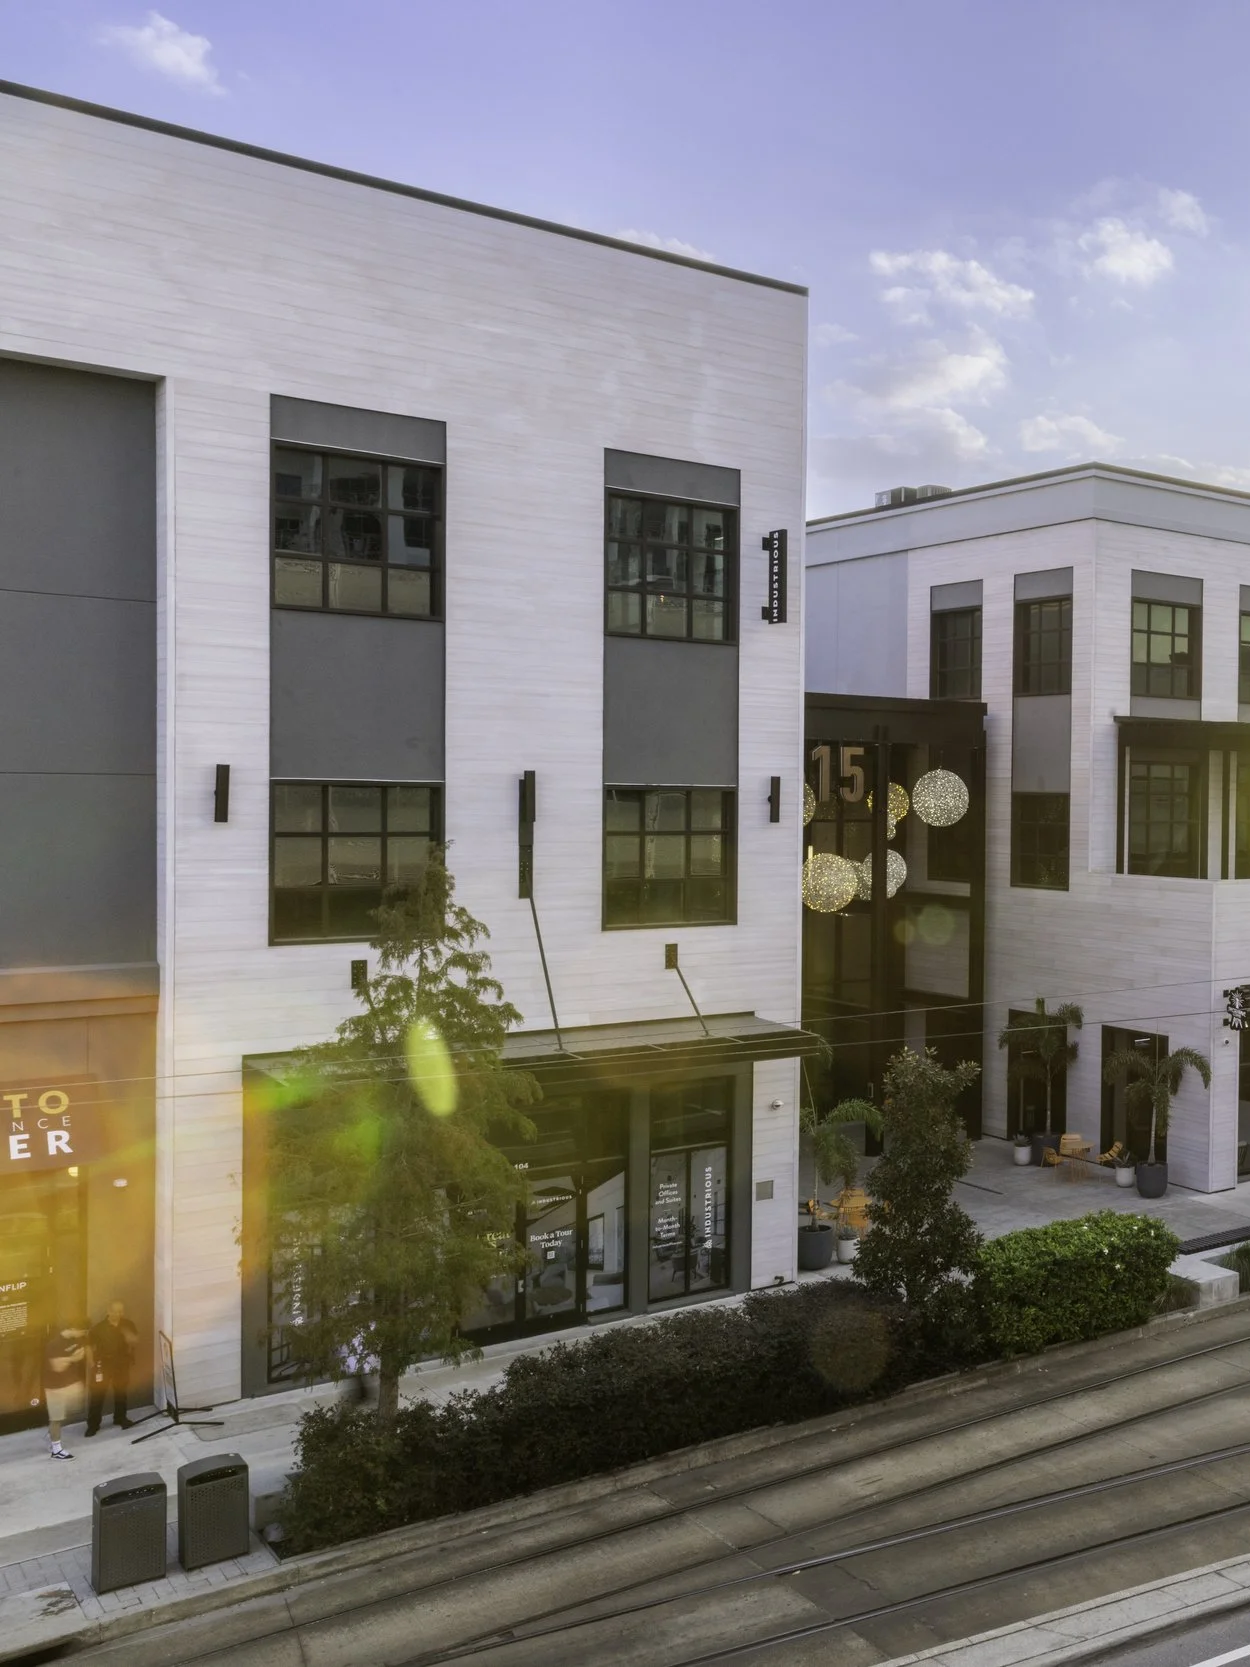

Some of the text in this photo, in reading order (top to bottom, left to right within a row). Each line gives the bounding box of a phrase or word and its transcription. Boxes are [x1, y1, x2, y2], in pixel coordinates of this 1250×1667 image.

[811, 745, 865, 802] 15
[3, 1090, 69, 1118] TO
[12, 1115, 72, 1132] NCE
[9, 1129, 74, 1160] ER
[514, 1162, 529, 1170] 104
[530, 1233, 550, 1242] Book
[556, 1229, 573, 1238] Tour
[540, 1239, 563, 1249] Today
